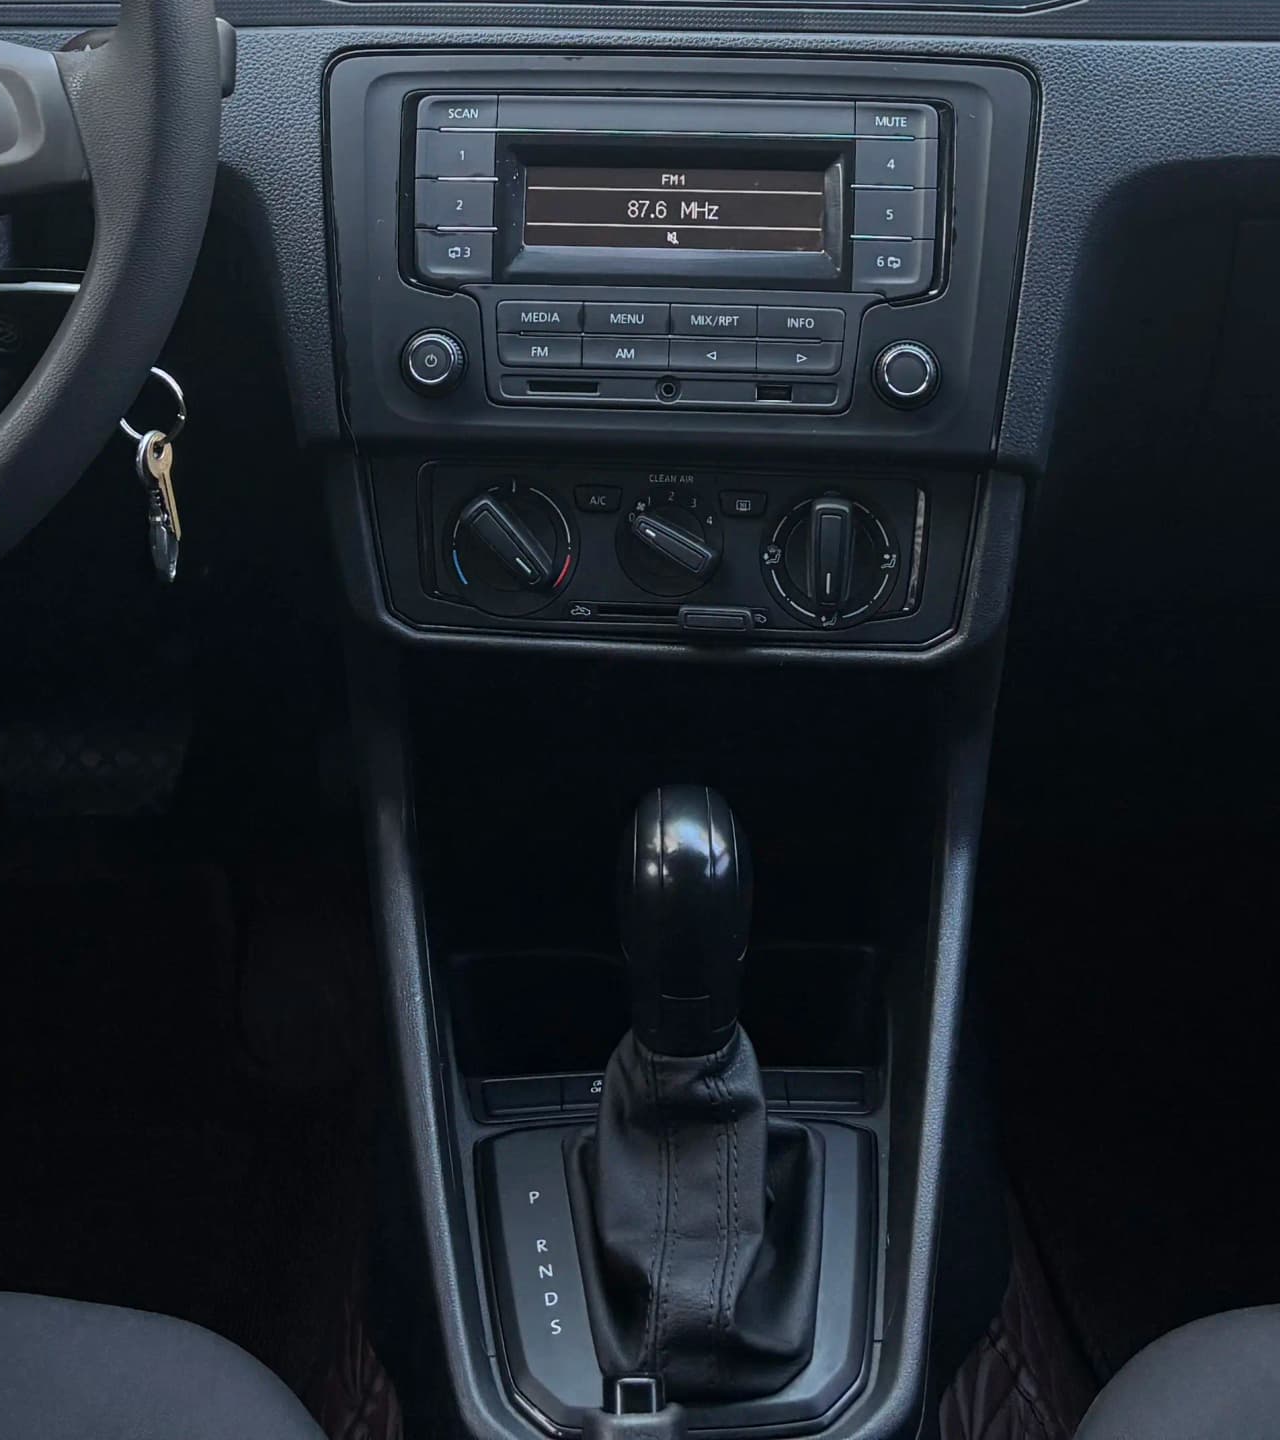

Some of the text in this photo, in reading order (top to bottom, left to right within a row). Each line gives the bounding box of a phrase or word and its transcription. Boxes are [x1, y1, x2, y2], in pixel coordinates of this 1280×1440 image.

[448, 108, 479, 119] SCAN
[875, 115, 908, 128] MUTE
[886, 158, 895, 170] 4
[661, 174, 685, 186] FM1
[454, 198, 464, 212] 2
[627, 199, 719, 220] 87.6 MHz
[886, 208, 894, 221] 5
[463, 246, 471, 258] 3
[876, 255, 885, 268] 6
[521, 311, 561, 323] MEDIA
[609, 313, 645, 325] MENU
[690, 314, 740, 327] MIX/RPT
[787, 317, 815, 329] INFO
[531, 346, 549, 357] FM
[615, 348, 635, 359] AM
[649, 473, 694, 483] CLEAN AIR
[589, 495, 606, 506] A/C
[667, 491, 675, 501] 2
[689, 497, 698, 510] 3
[706, 515, 713, 525] 4
[528, 1191, 540, 1205] P
[536, 1239, 548, 1253] R
[538, 1263, 554, 1279] N
[544, 1291, 559, 1307] D
[550, 1319, 562, 1335] S
